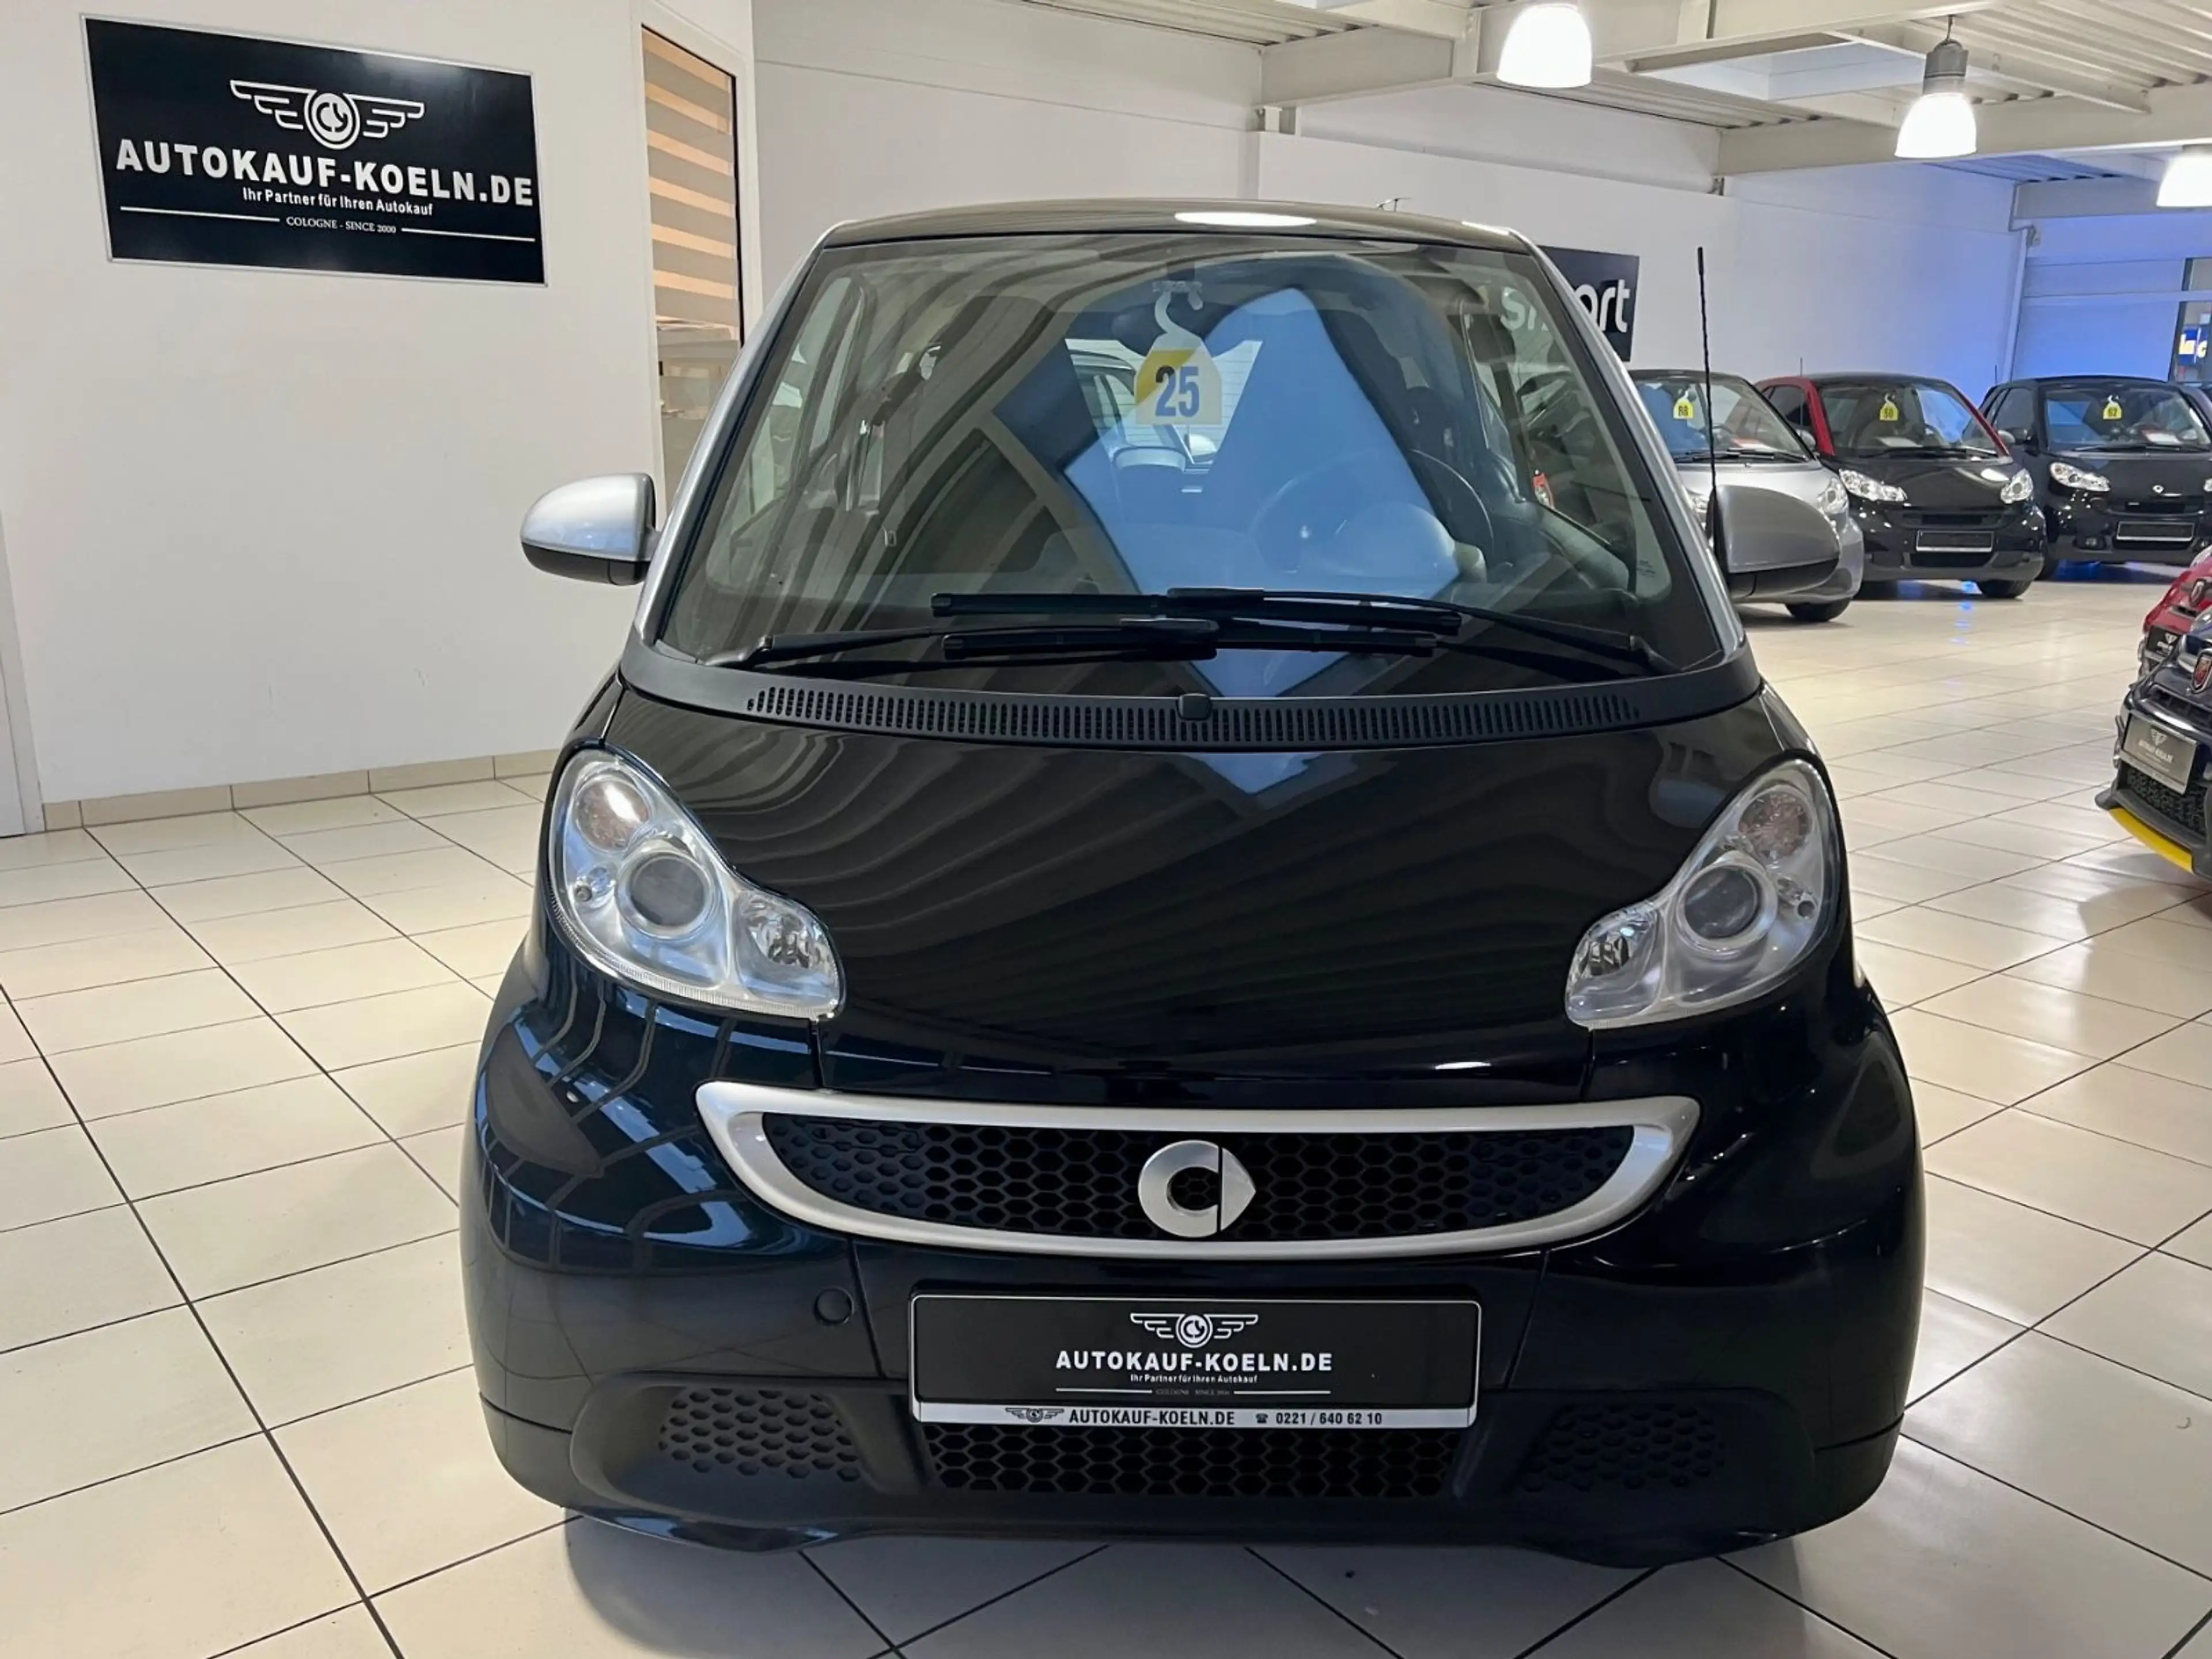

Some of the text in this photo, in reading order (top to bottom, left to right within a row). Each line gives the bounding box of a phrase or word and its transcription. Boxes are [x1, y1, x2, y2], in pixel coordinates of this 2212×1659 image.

[116, 139, 533, 206] AUTOKAUF-KOELN.DE
[243, 187, 433, 216] Ihr Partner für Ihren Autokauf
[286, 216, 338, 229] COLOGNE
[345, 221, 375, 232] SINCE
[377, 225, 397, 233] 2000
[1155, 365, 1200, 418] 25
[1056, 1351, 1332, 1372] AUTOKAUF-KOELN.DE
[1130, 1374, 1143, 1382] Ihr
[1144, 1374, 1177, 1382] Partner
[1192, 1374, 1216, 1382] Ihren
[1218, 1374, 1257, 1382] Autokauf
[1069, 1409, 1382, 1425] AUTOKAUF-KOELN.DE 0221 / 640 62 10
